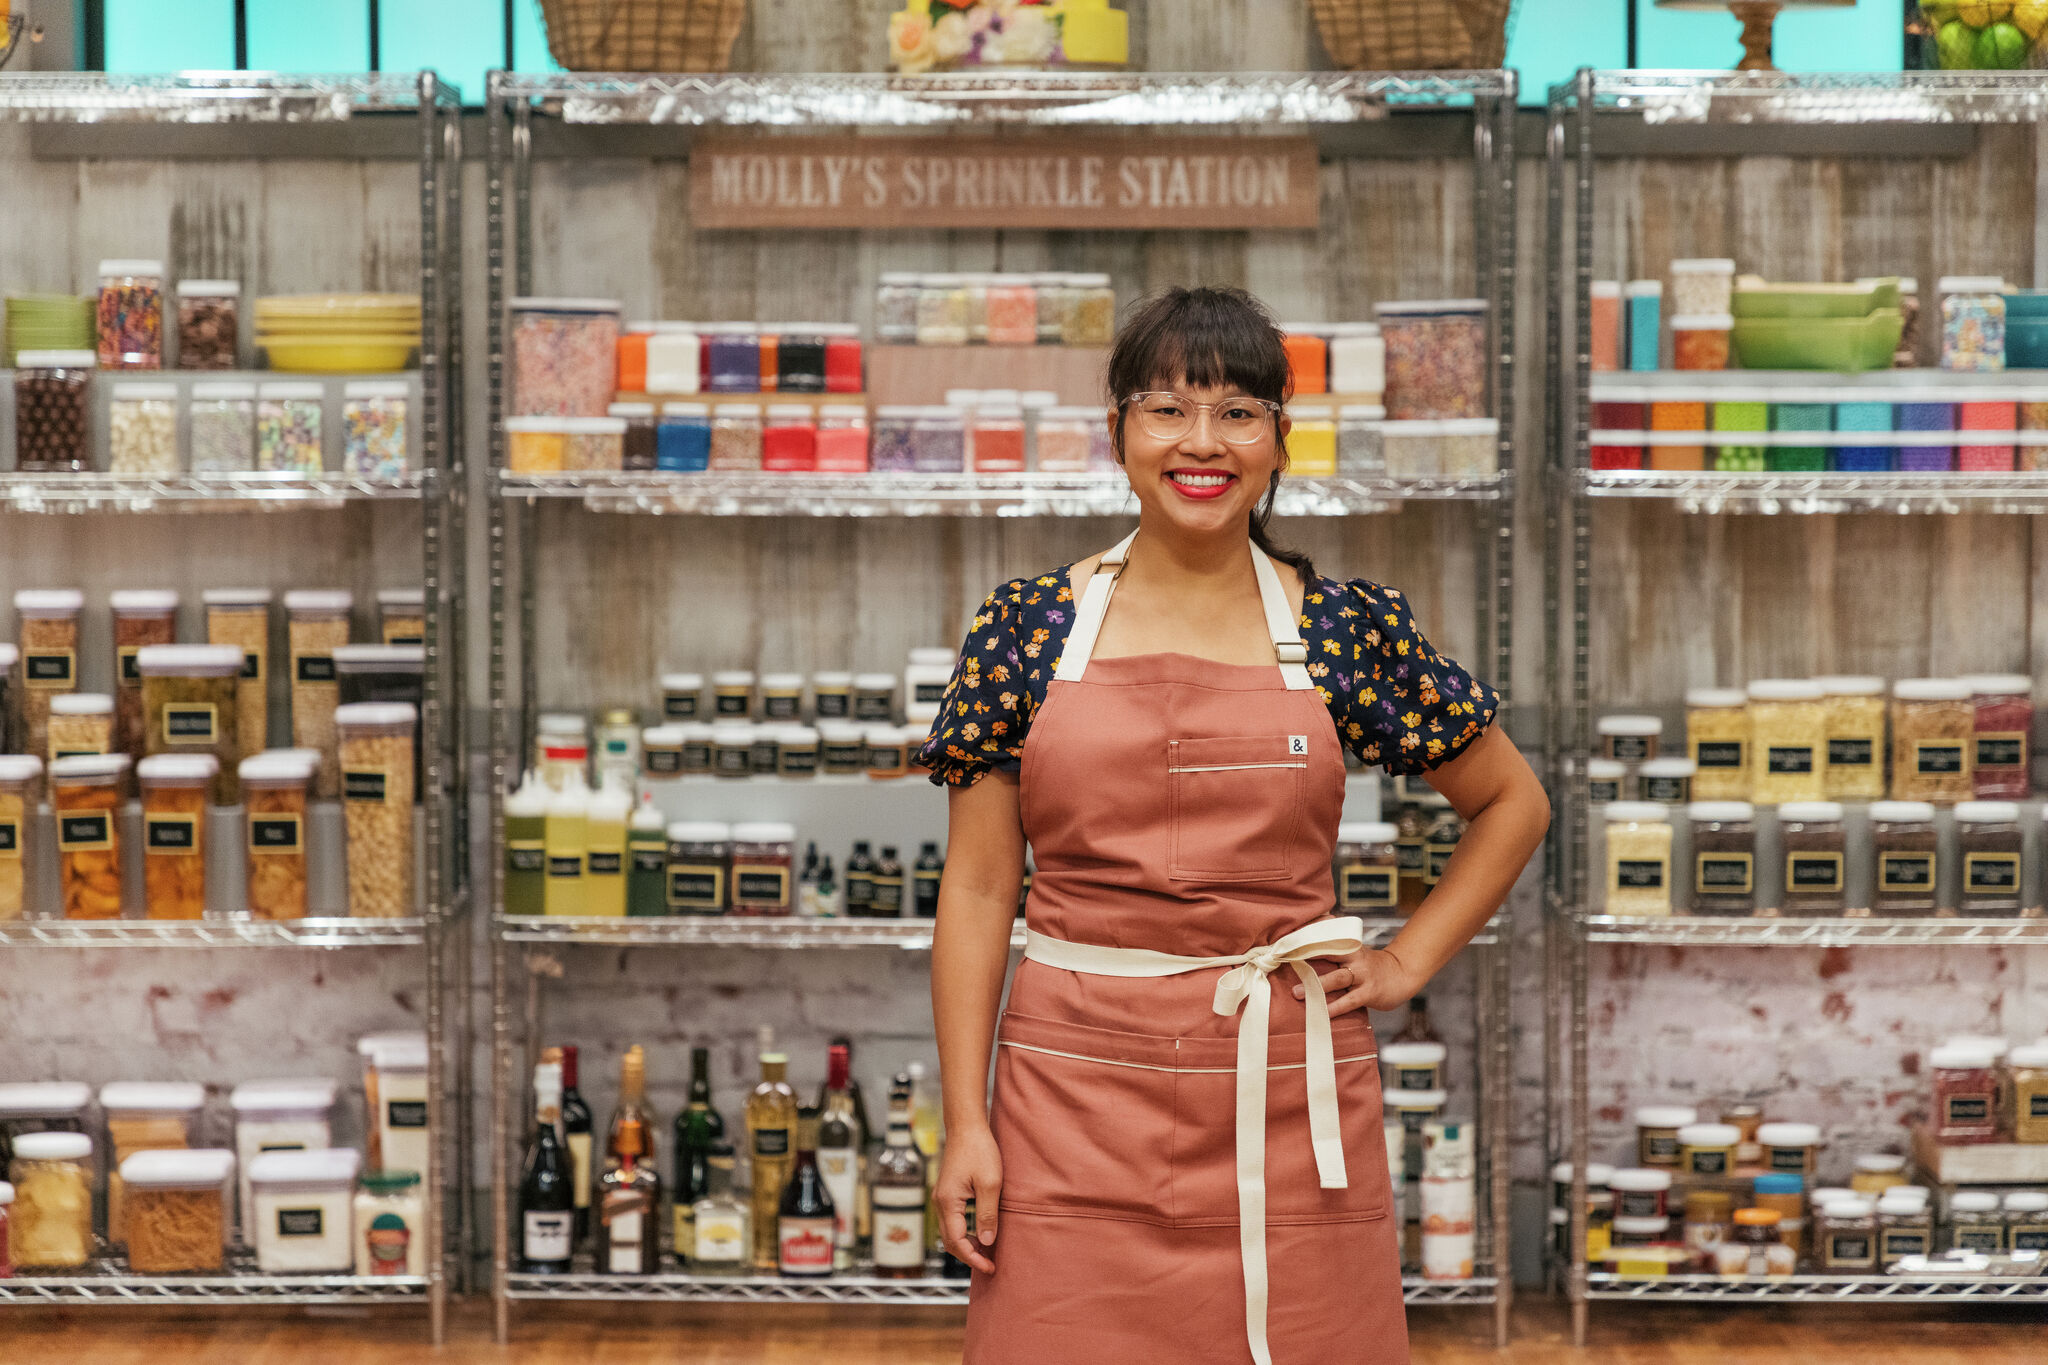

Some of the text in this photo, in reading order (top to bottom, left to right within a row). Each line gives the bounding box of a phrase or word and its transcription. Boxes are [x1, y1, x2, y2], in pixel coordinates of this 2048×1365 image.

[711, 155, 1290, 207] MOLLY'S SPRINKLE STATION
[1293, 738, 1303, 752] &
